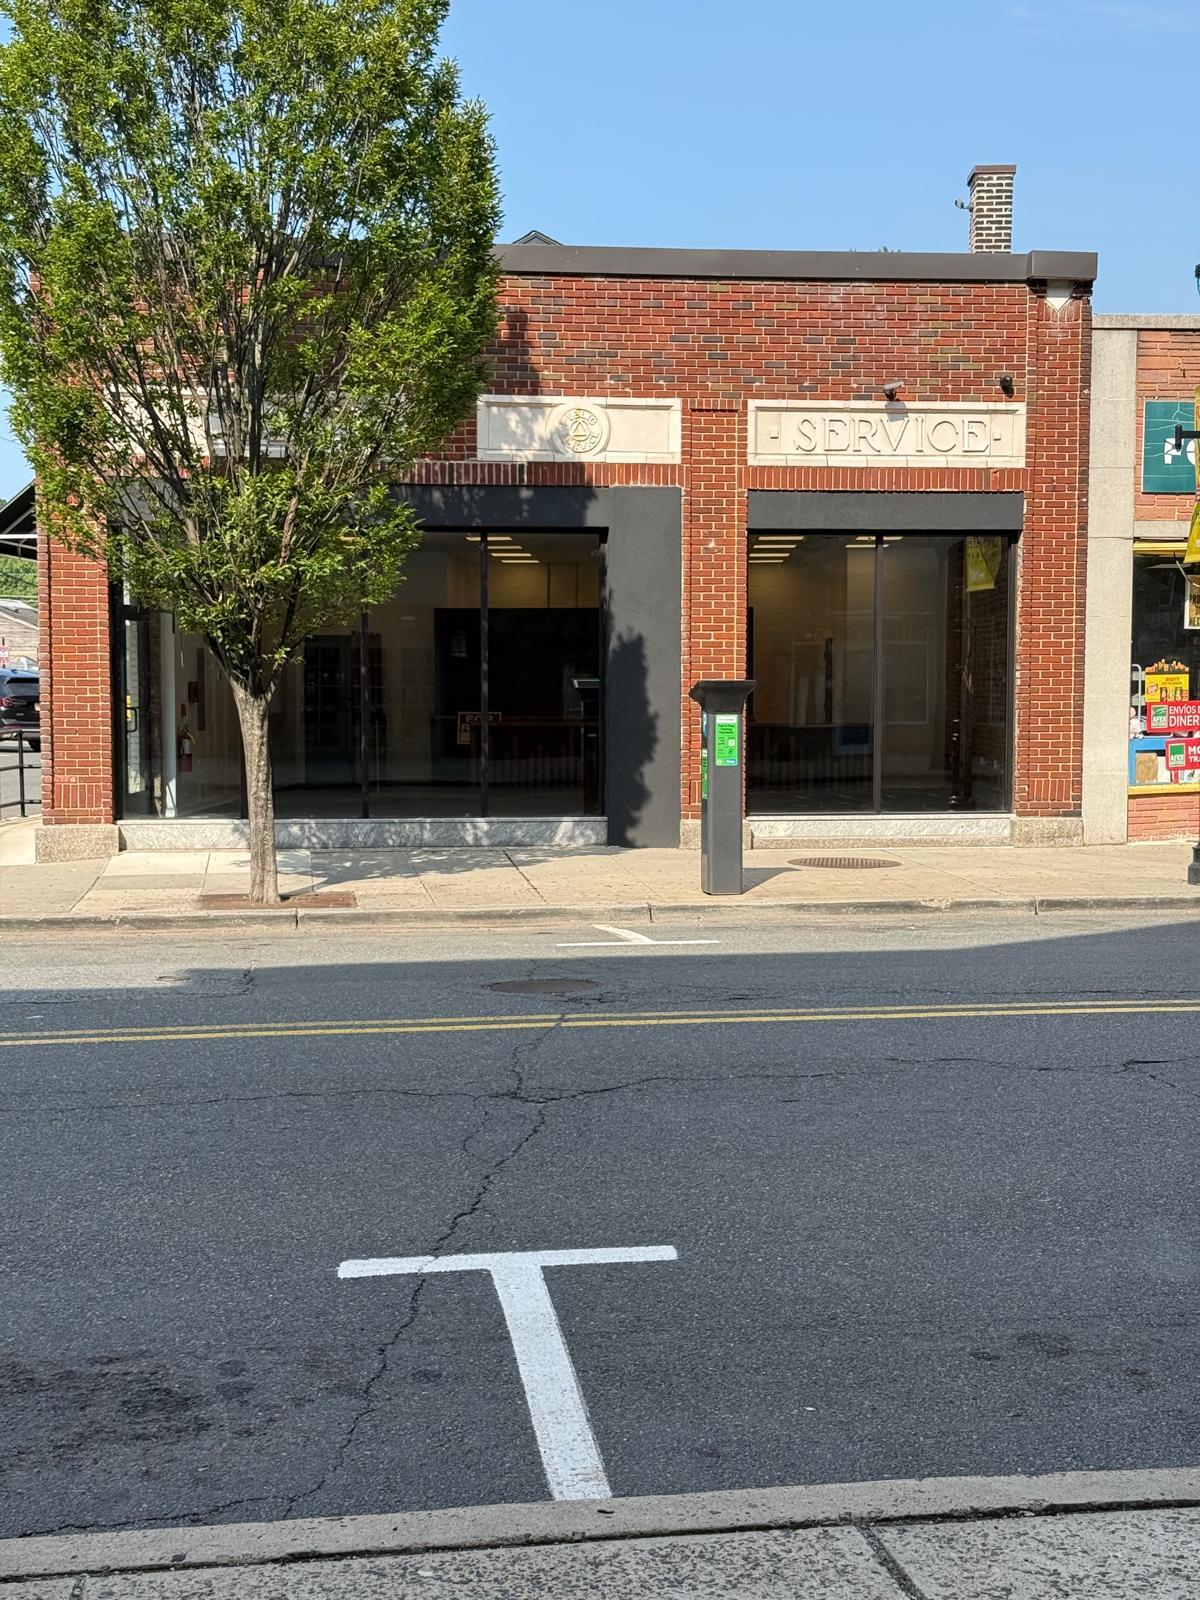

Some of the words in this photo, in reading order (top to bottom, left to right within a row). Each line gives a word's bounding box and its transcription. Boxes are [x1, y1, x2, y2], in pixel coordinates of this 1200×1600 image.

[793, 416, 990, 453] SERVICE
[1169, 704, 1197, 715] ENVÍOS
[1169, 715, 1200, 728] DINER
